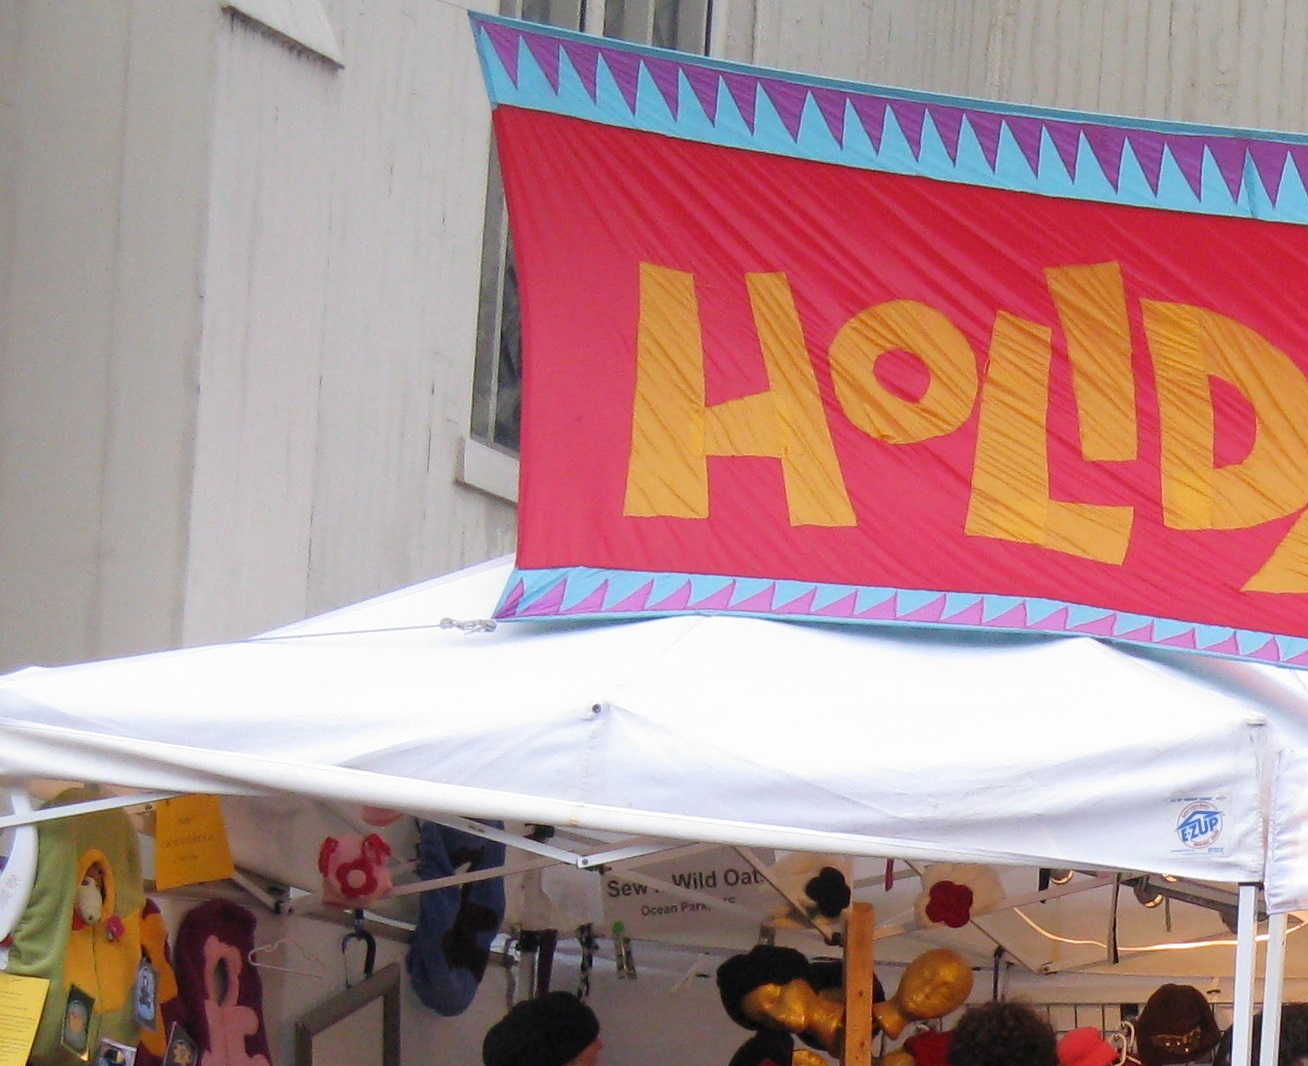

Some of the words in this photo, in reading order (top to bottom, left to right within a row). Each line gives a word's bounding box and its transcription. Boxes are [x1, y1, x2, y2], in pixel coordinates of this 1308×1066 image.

[607, 880, 648, 898] Sew
[672, 869, 717, 890] Wild
[723, 867, 765, 888] Oat
[641, 904, 678, 916] Ocean
